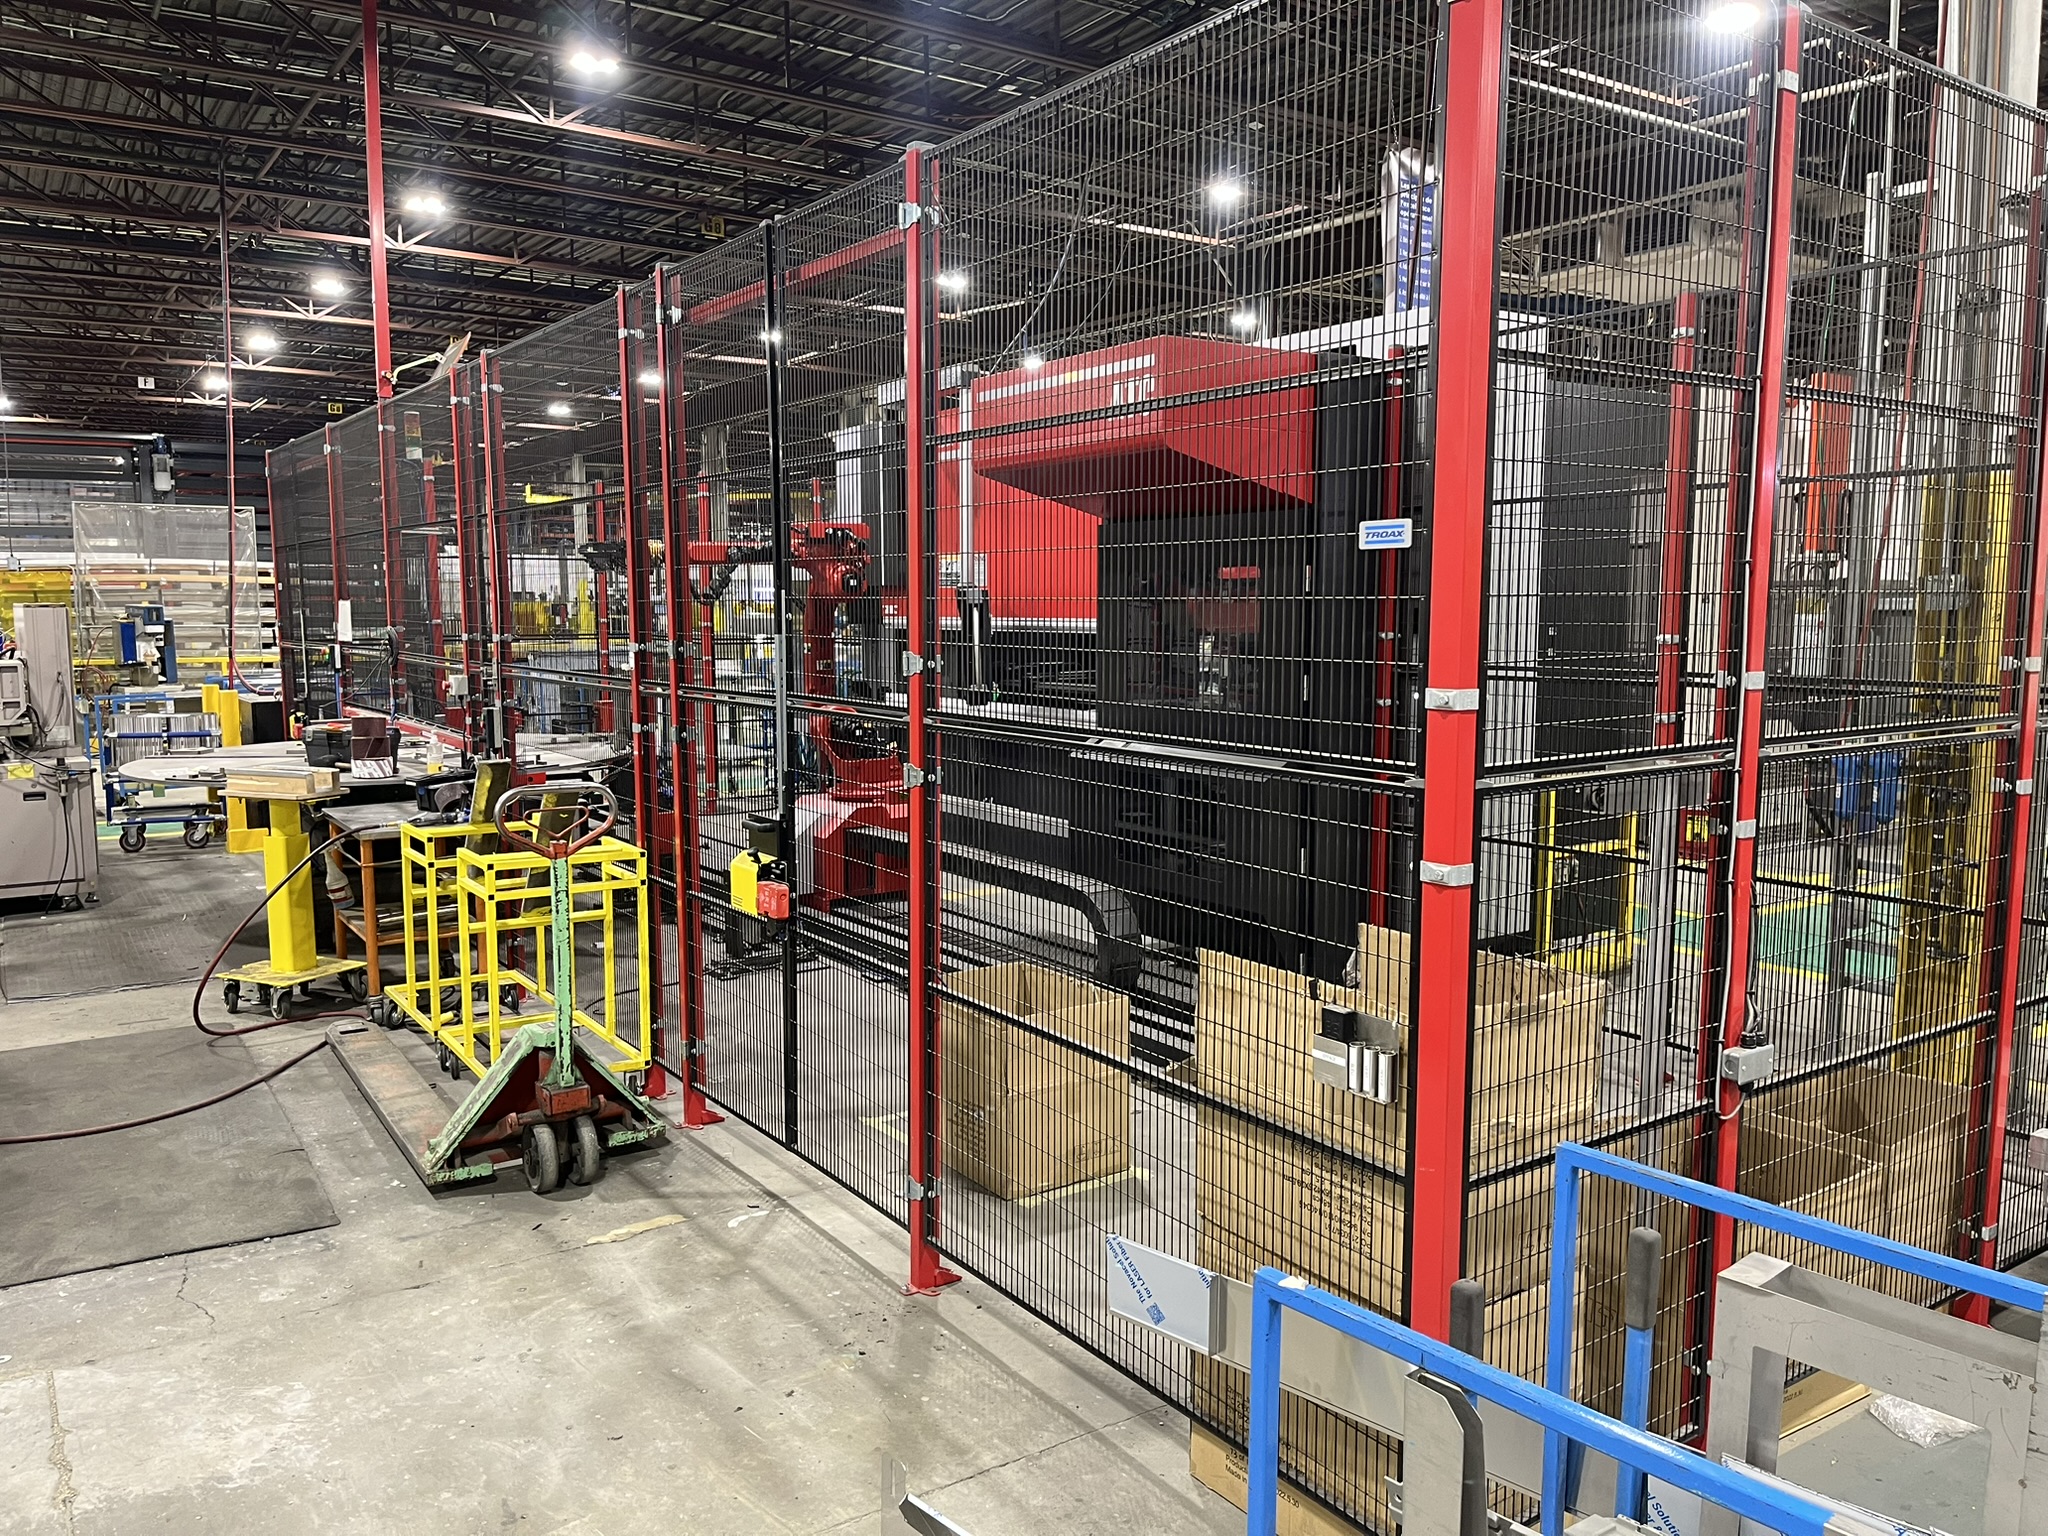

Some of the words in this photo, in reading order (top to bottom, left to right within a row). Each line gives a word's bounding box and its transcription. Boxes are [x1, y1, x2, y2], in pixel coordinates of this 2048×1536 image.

[1365, 530, 1403, 539] TROAX
[1117, 1259, 1138, 1289] Novacel
[1127, 1259, 1146, 1287] LASER
[1143, 1287, 1153, 1299] for
